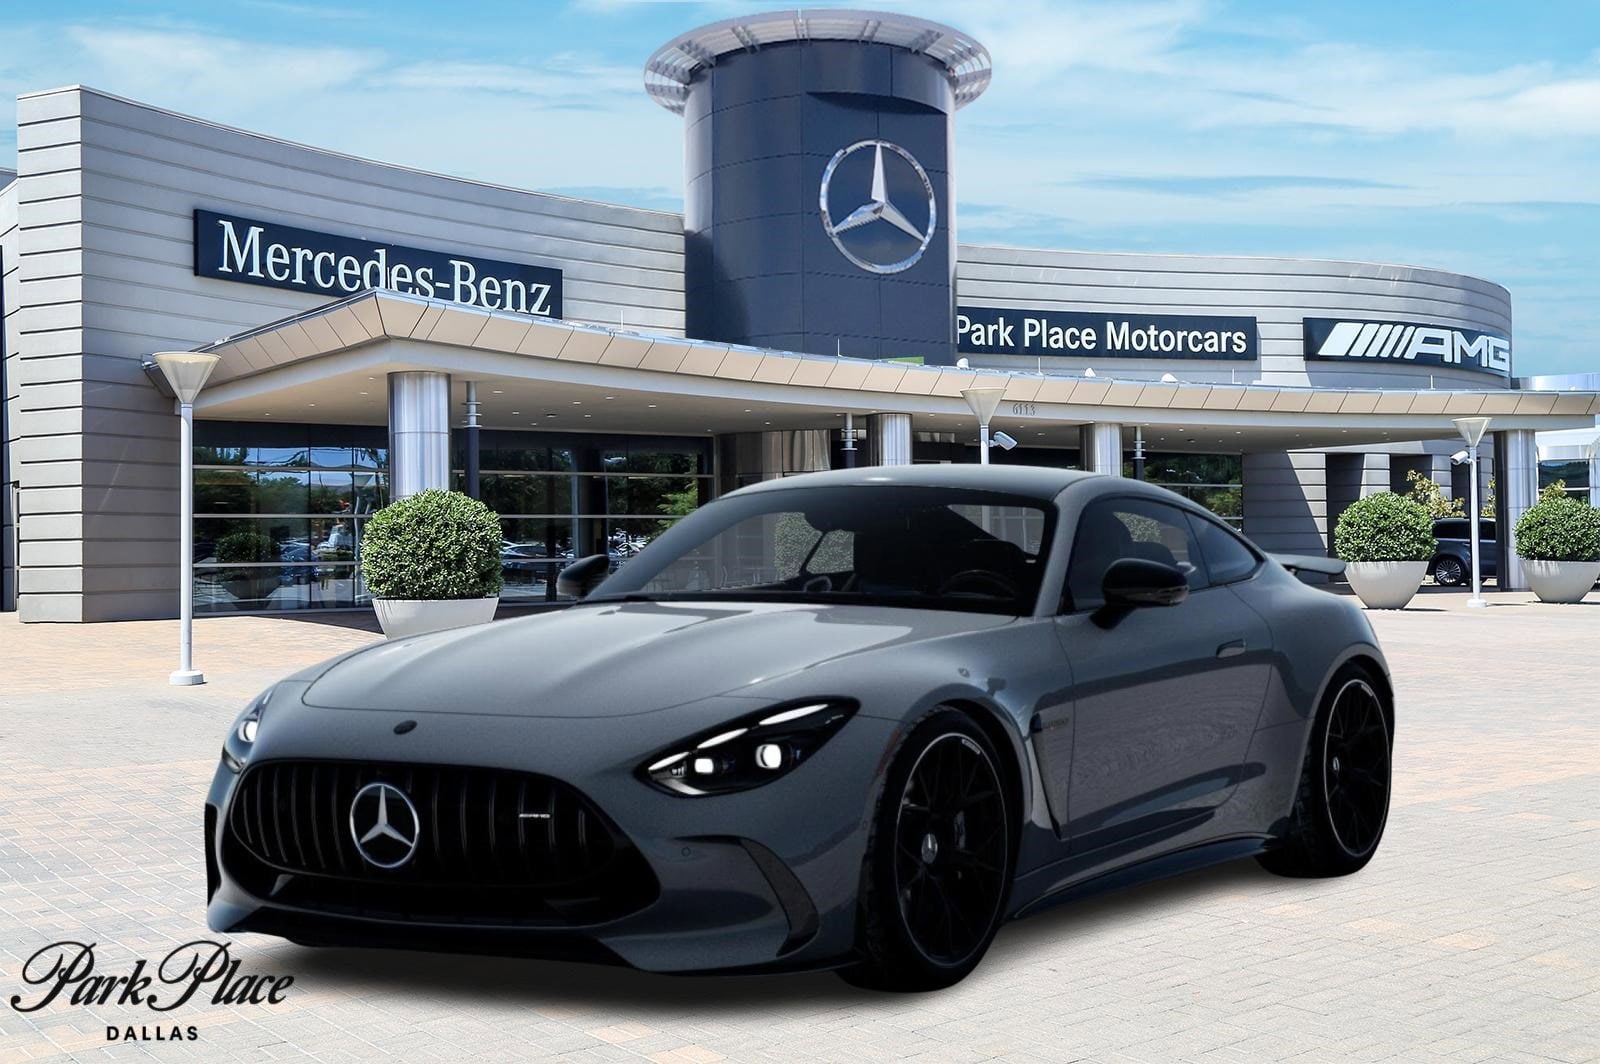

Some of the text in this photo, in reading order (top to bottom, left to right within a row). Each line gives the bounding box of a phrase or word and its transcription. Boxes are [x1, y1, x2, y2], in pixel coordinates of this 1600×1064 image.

[218, 219, 552, 316] Mercedes-Benz
[956, 314, 1248, 353] Park Place Motorcars
[1403, 326, 1510, 372] AMG
[1012, 402, 1037, 416] 6113
